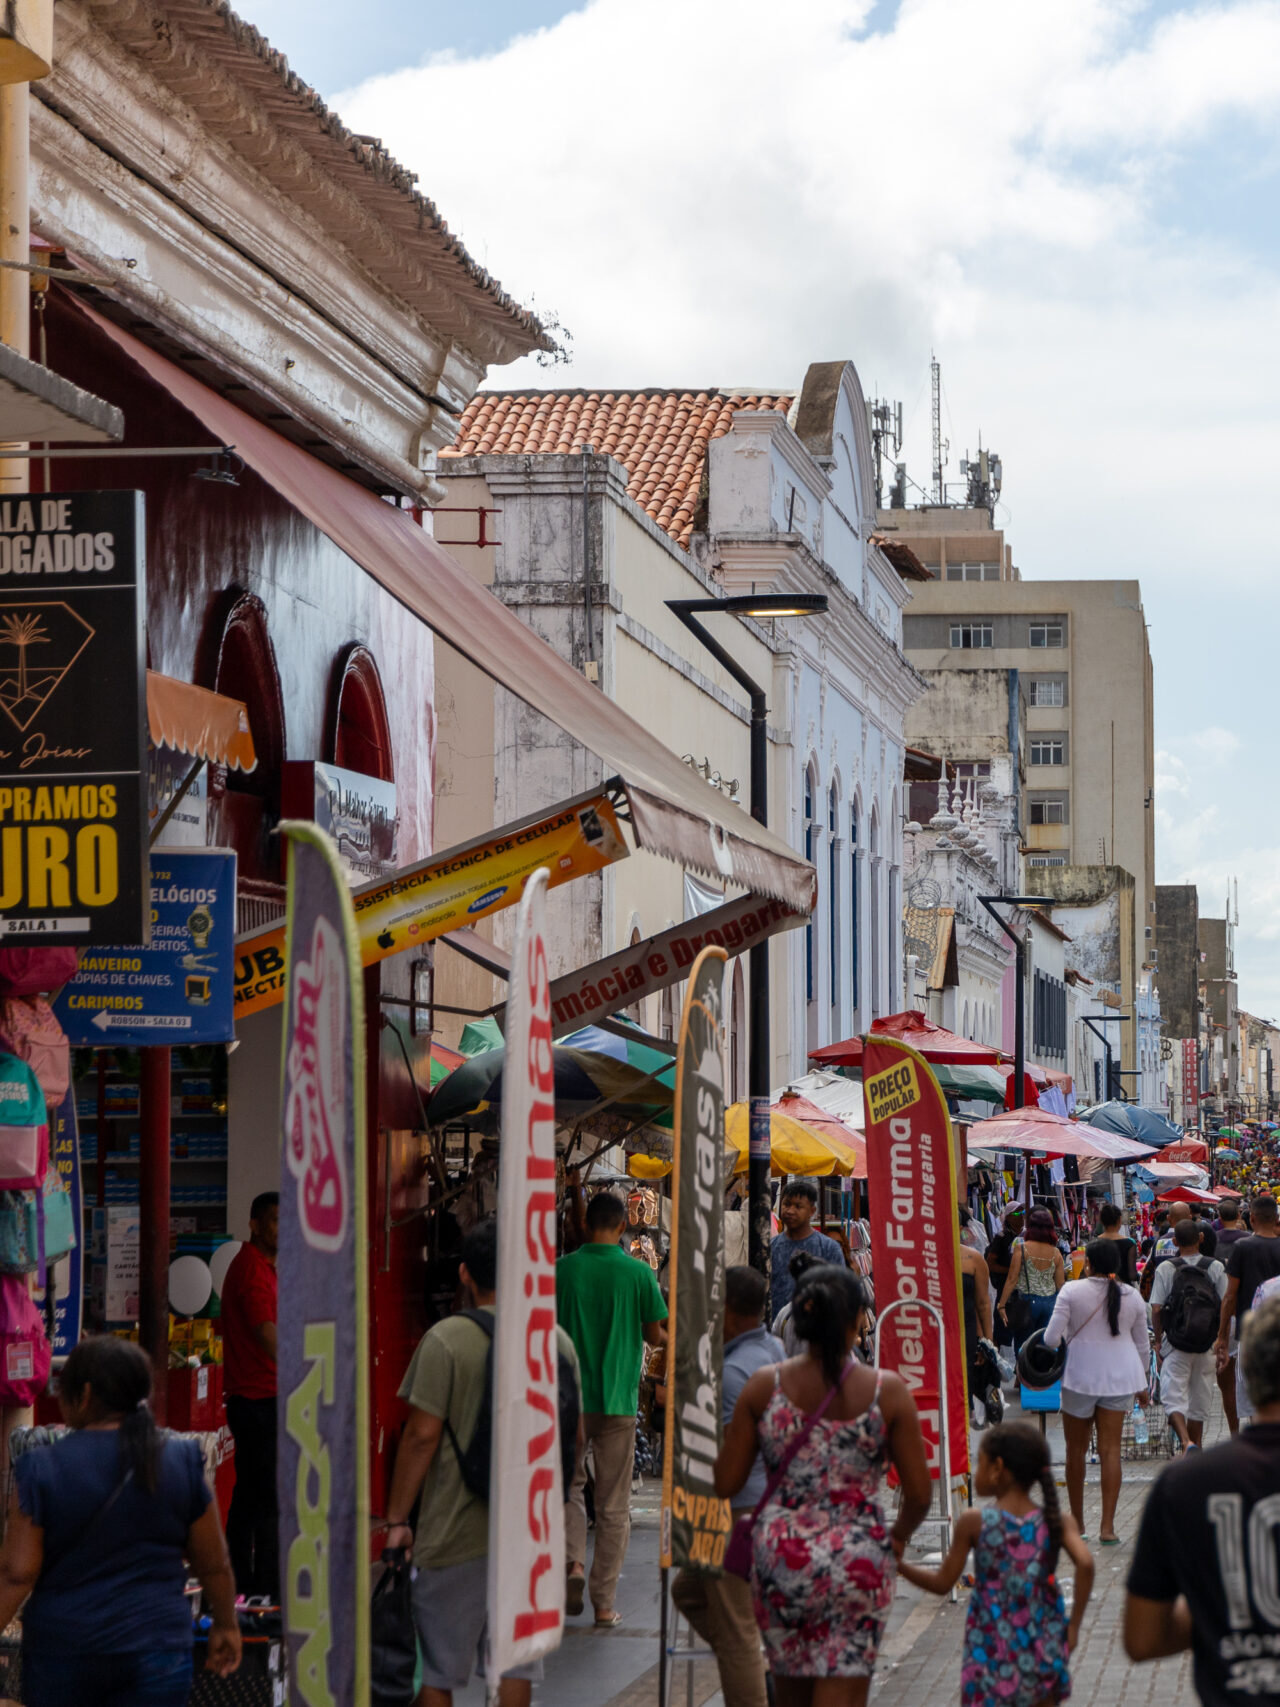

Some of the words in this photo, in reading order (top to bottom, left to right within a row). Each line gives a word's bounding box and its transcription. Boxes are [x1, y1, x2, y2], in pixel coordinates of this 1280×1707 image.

[0, 500, 35, 532] LA
[41, 499, 72, 531] DE
[20, 732, 92, 768] Joias
[156, 871, 172, 880] 732
[353, 873, 432, 912] SSISTÊNCIA
[434, 848, 495, 880] TÉCNICA
[495, 839, 515, 856] DE
[516, 812, 577, 847] CELULAR
[150, 884, 217, 904] ELÓGIOS
[470, 888, 508, 910] SAMSUNG
[8, 919, 46, 932] SALA
[52, 919, 58, 931] 1
[419, 909, 457, 930] motorola
[646, 952, 669, 977] e
[669, 899, 800, 969] Drogaria
[110, 973, 127, 985] DE
[68, 995, 144, 1010] CARIMBOS
[111, 1016, 146, 1026] ROBSON
[153, 1017, 175, 1026] SALA
[176, 1017, 187, 1027] 03
[869, 1065, 911, 1104] PREÇO
[873, 1089, 915, 1122] POPULAR
[886, 1118, 915, 1249] Farma
[920, 1133, 937, 1219] Drogaria
[923, 1224, 936, 1235] e
[512, 932, 561, 1642] havaianas
[922, 1241, 945, 1328] Farmácia
[895, 1257, 926, 1391] Melhor
[1220, 1629, 1263, 1660] SÃO
